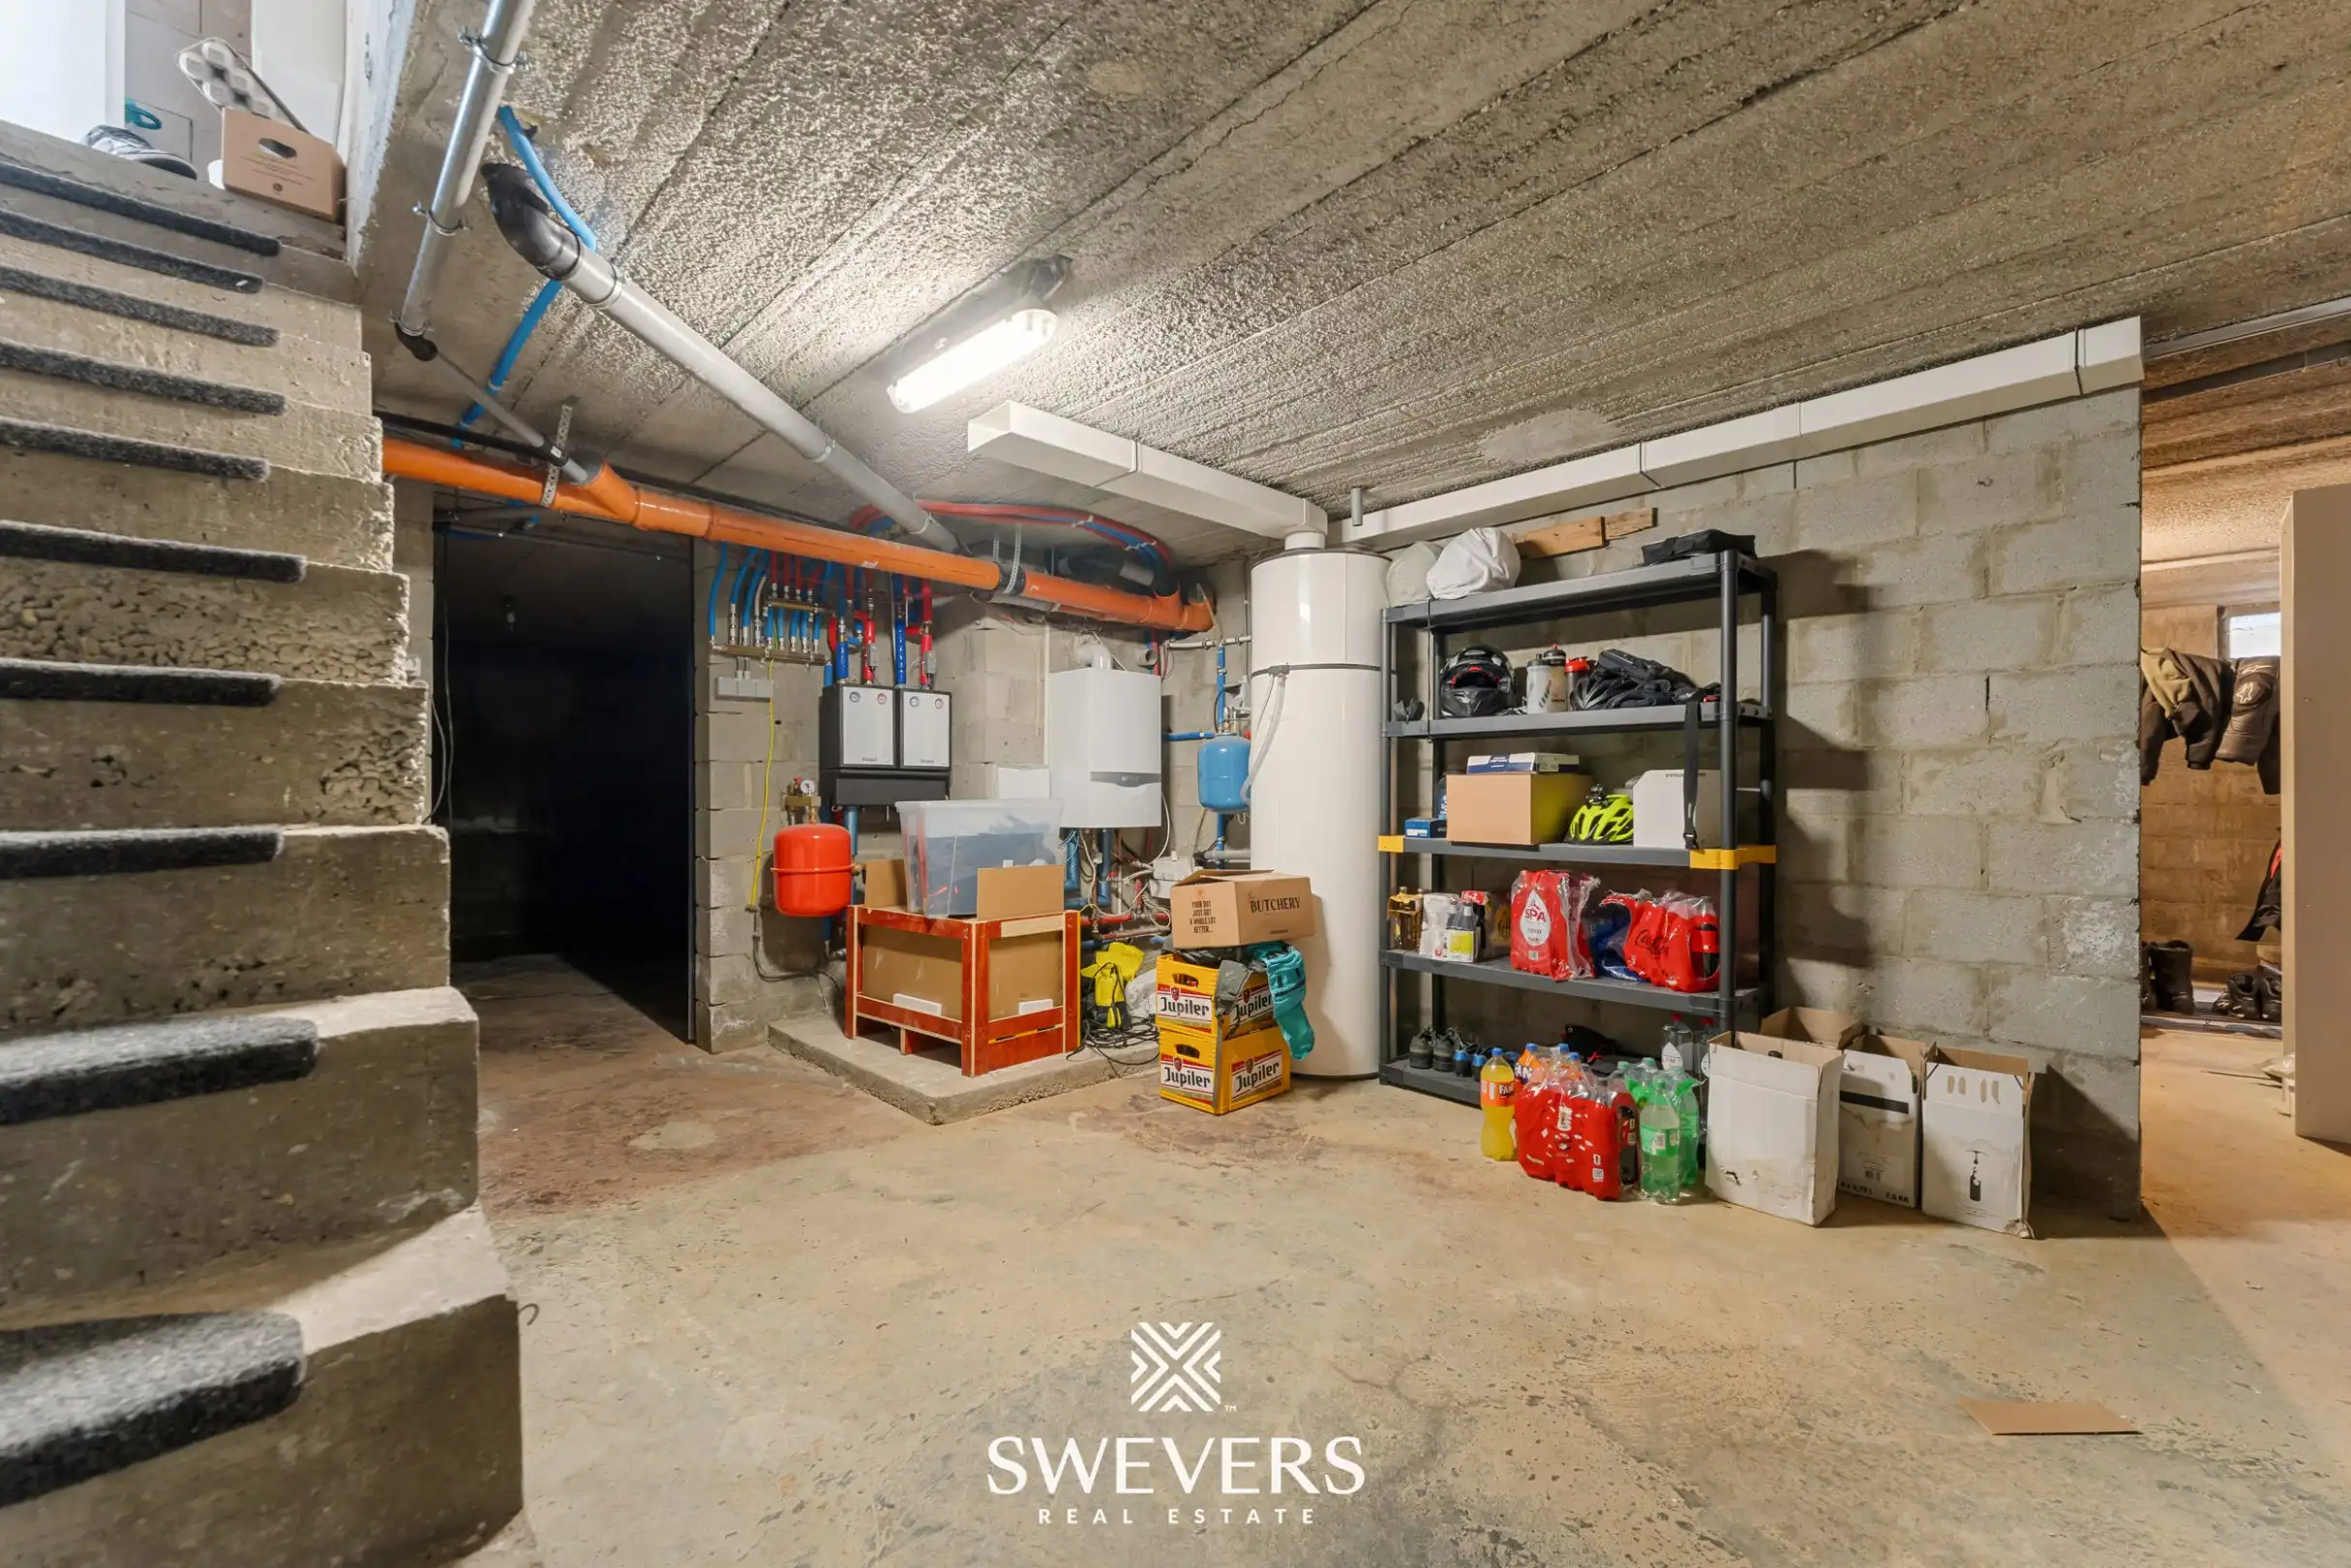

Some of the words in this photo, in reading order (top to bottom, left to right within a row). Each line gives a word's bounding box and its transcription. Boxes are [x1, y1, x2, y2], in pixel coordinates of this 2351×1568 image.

[1192, 909, 1202, 918] JUST
[1250, 896, 1300, 913] BUTCHERY
[1524, 909, 1547, 922] SPA
[1160, 997, 1209, 1016] Jupiler
[1234, 995, 1272, 1020] Jupiler
[1164, 1067, 1211, 1088] Jupiler
[1236, 1063, 1280, 1092] Jupiler
